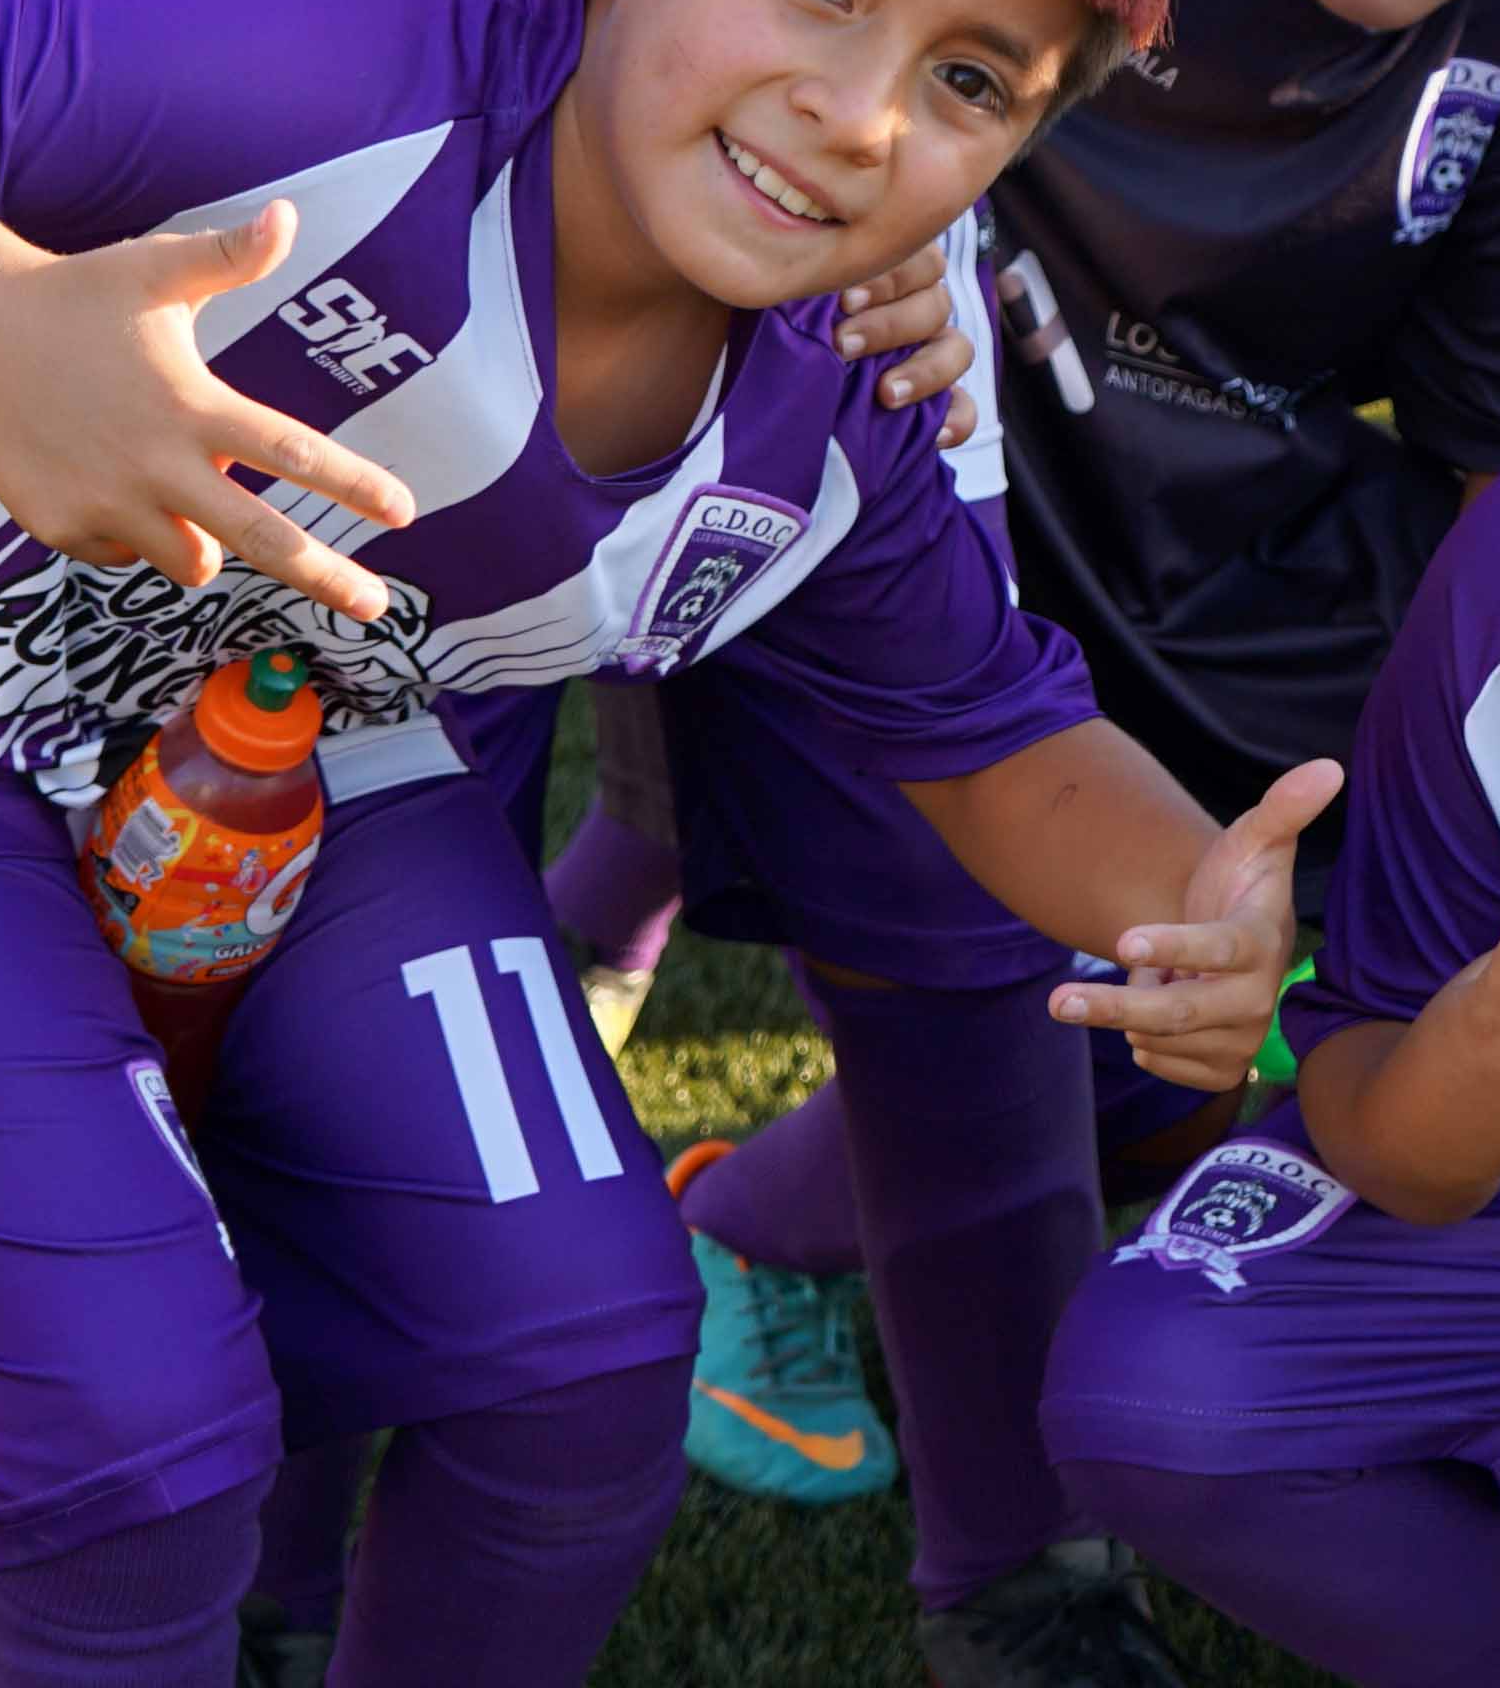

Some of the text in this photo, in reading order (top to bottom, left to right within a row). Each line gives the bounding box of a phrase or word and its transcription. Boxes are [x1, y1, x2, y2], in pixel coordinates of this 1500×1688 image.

[700, 505, 794, 545] C.D.O.C
[401, 936, 625, 1205] 11
[1215, 1148, 1337, 1196] C.D.O.C
